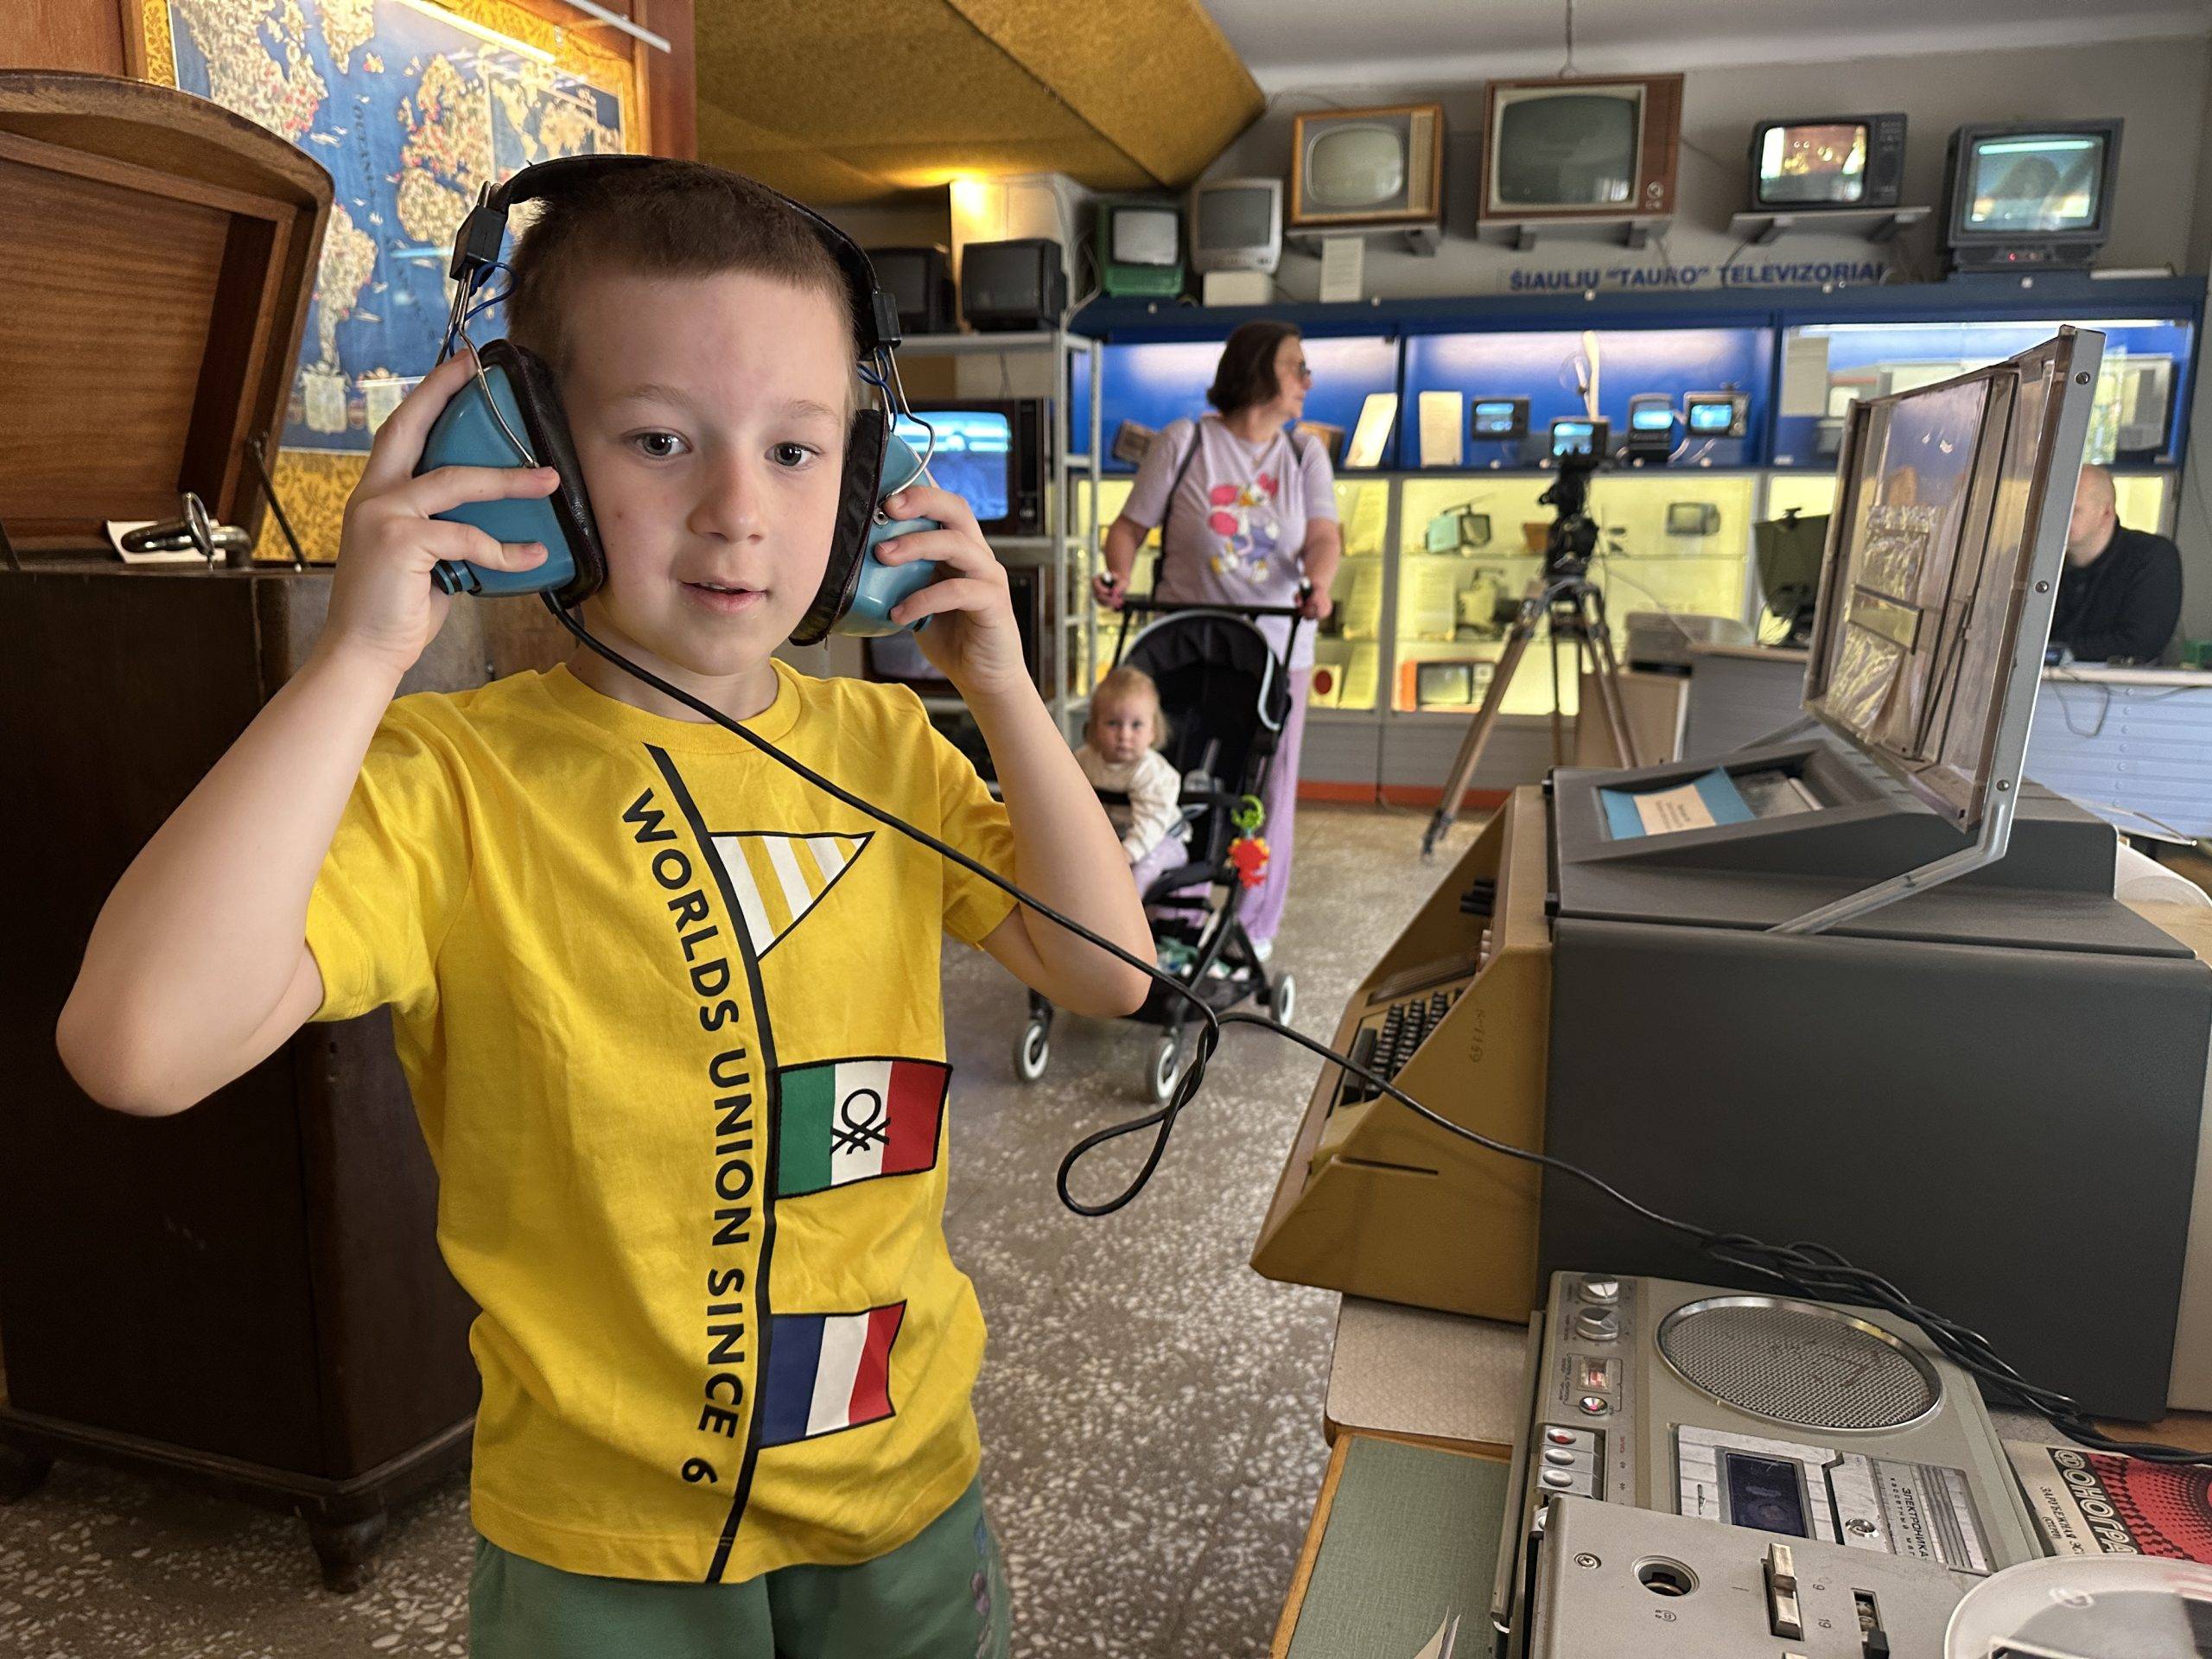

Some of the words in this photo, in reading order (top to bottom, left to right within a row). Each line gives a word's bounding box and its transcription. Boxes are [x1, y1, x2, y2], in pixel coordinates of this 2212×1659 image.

[1718, 263, 1884, 284] TELEVIZORIAI
[622, 787, 740, 1032] WORLDS
[709, 1048, 753, 1246] UNION
[697, 1268, 745, 1438] SINCE
[682, 1457, 718, 1484] 6
[1902, 1487, 1929, 1557] ЭЛЕКТРОНИКА
[2039, 1486, 2077, 1539] ЗАРУБЕЖНАЯ
